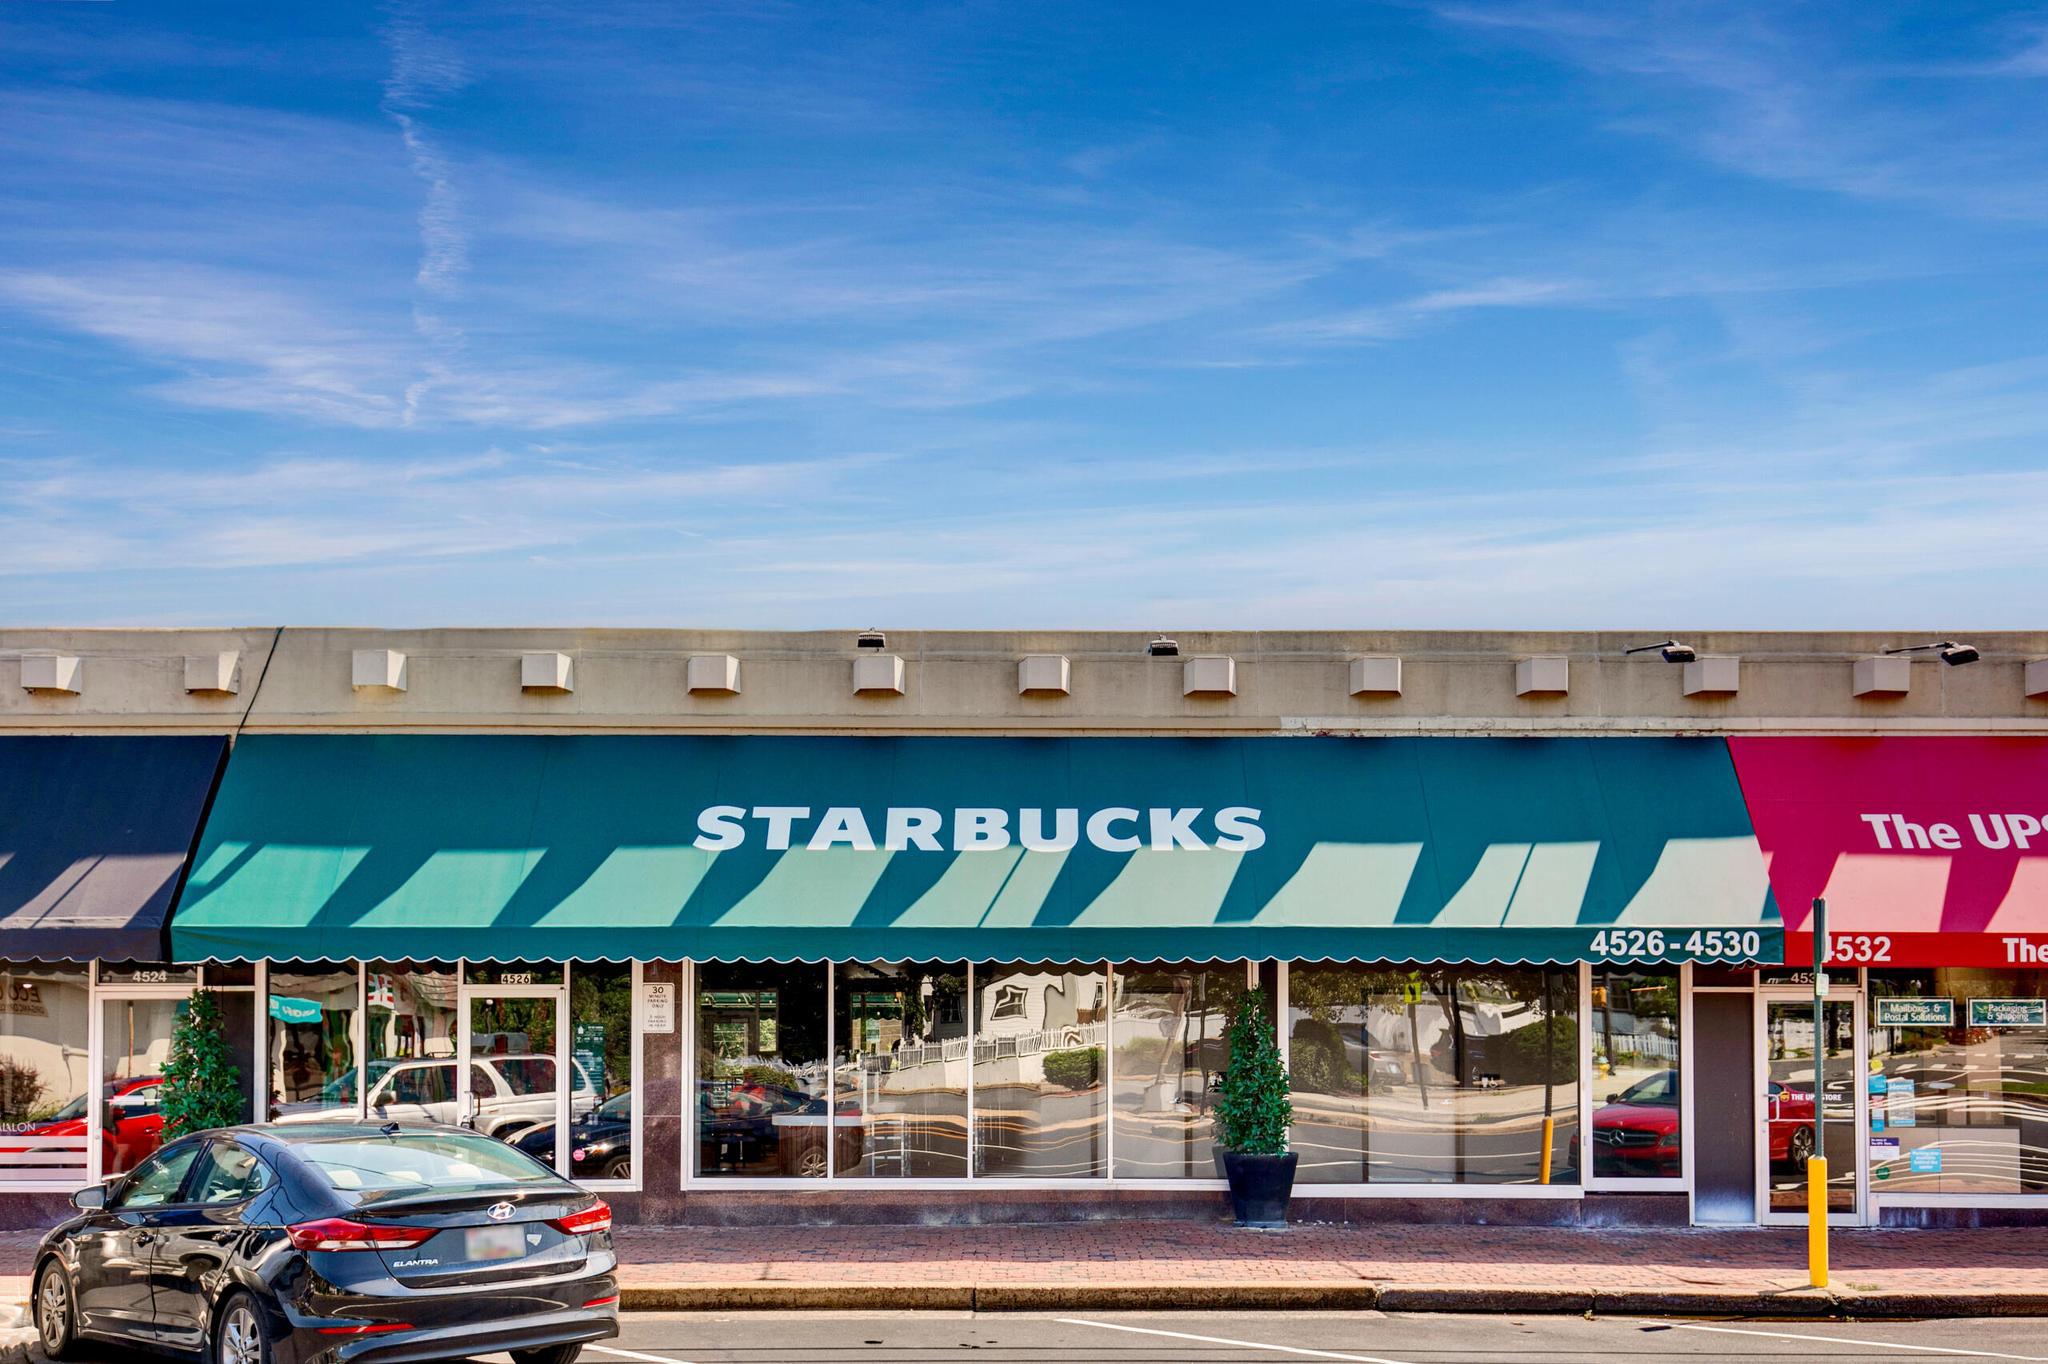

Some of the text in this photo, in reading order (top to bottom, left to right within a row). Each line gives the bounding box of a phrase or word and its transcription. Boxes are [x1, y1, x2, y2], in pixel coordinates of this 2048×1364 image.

[692, 804, 1267, 853] STARBUCKS
[1860, 813, 1962, 850] The
[2002, 937, 2048, 963] The
[132, 971, 168, 983] 4524
[502, 974, 530, 984] 4526
[1790, 972, 1815, 984] 453
[652, 986, 664, 994] 30
[1890, 1003, 1941, 1013] Mailboxes &
[1988, 1004, 2028, 1015] Packaging
[1884, 1013, 1946, 1022] Postal Solutions
[1996, 1012, 2029, 1022] Shipping
[1791, 1093, 1804, 1101] THE
[1805, 1093, 1815, 1101] UP
[393, 1258, 439, 1268] ELANTRA
